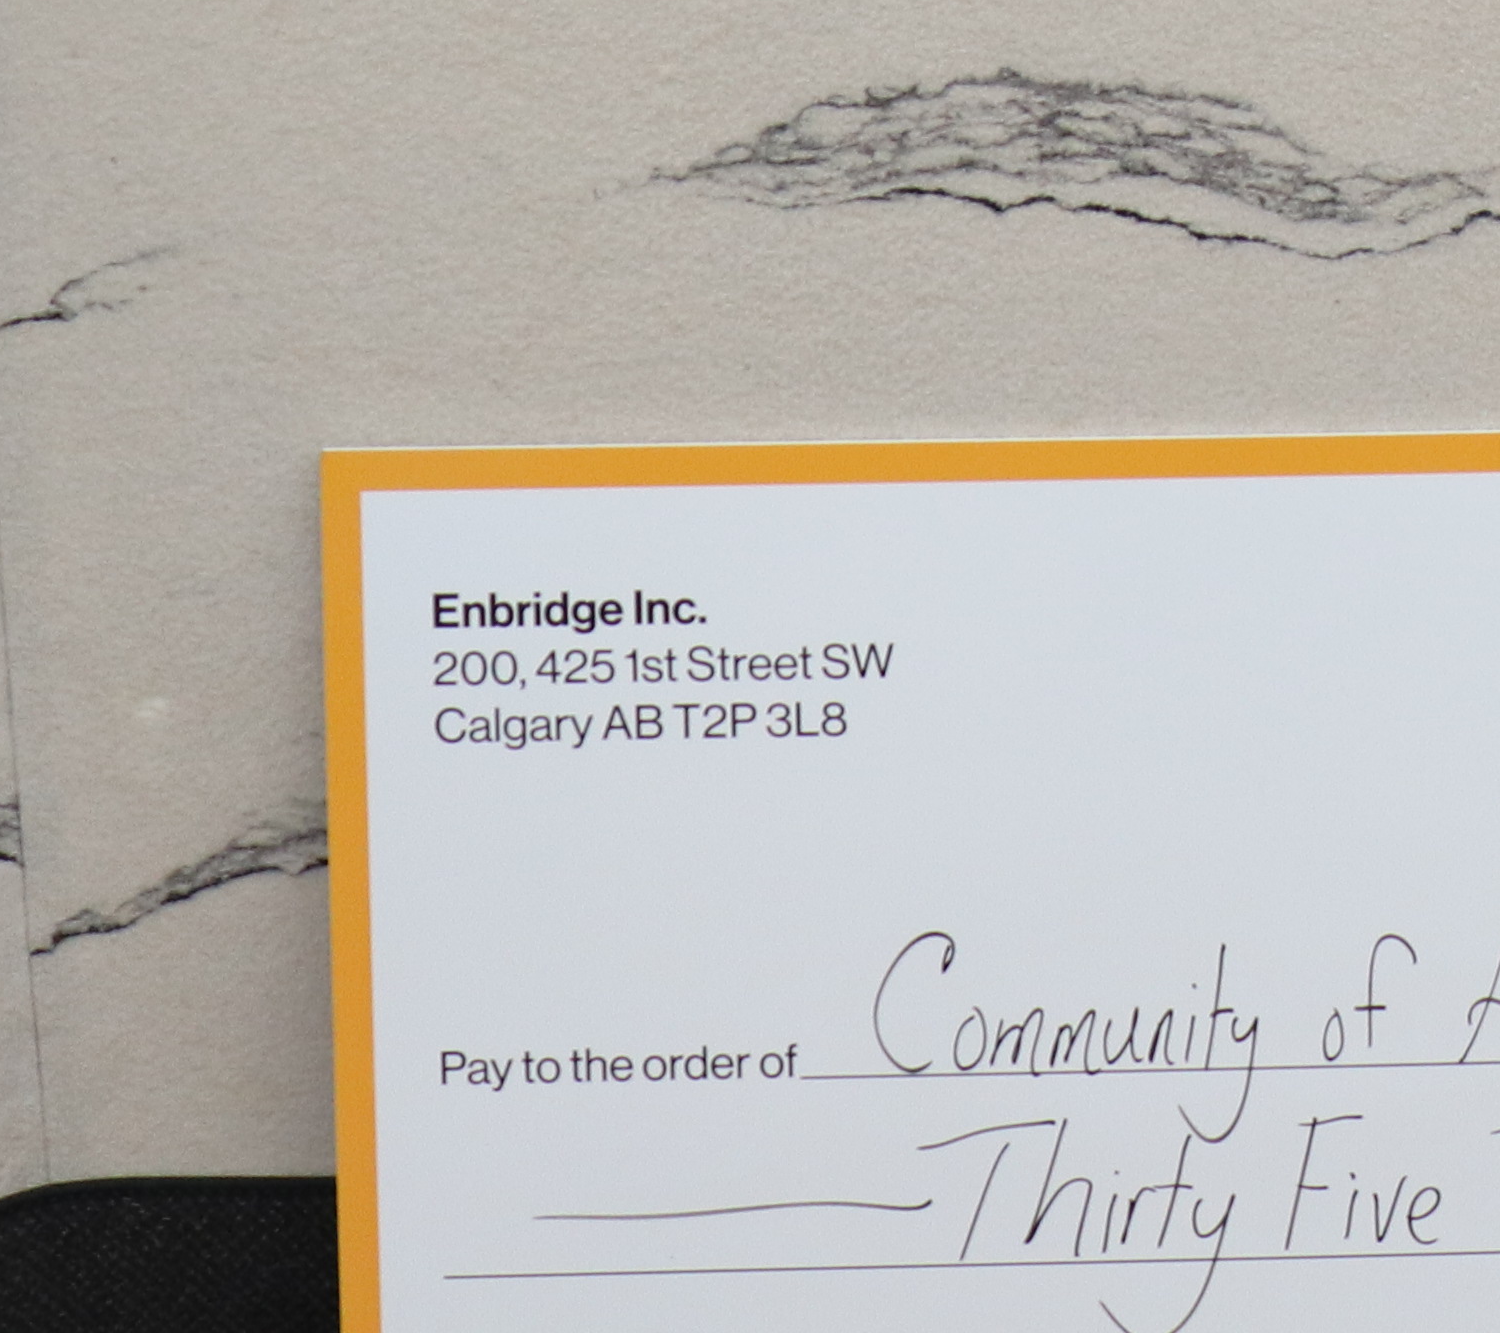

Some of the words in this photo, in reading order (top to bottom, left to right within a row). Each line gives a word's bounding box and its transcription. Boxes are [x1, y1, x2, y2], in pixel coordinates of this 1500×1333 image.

[432, 592, 625, 634] Enbridge
[633, 590, 708, 625] Inc.
[432, 649, 528, 690] 200,
[535, 648, 616, 684] 425
[625, 646, 678, 684] 1st
[686, 643, 813, 682] Street
[820, 641, 896, 680] SW
[434, 706, 594, 751] Calgary
[601, 704, 664, 741] AB
[672, 701, 759, 740] T2P
[764, 700, 849, 738] 3L8
[873, 930, 1260, 1144] Community
[1322, 933, 1418, 1062] of
[439, 1049, 515, 1091] Pay
[523, 1049, 563, 1085] to
[570, 1046, 637, 1083] the
[642, 1043, 751, 1083] order
[758, 1041, 799, 1081] of
[916, 1116, 1237, 1333] Thirty
[1285, 1113, 1443, 1252] Five
